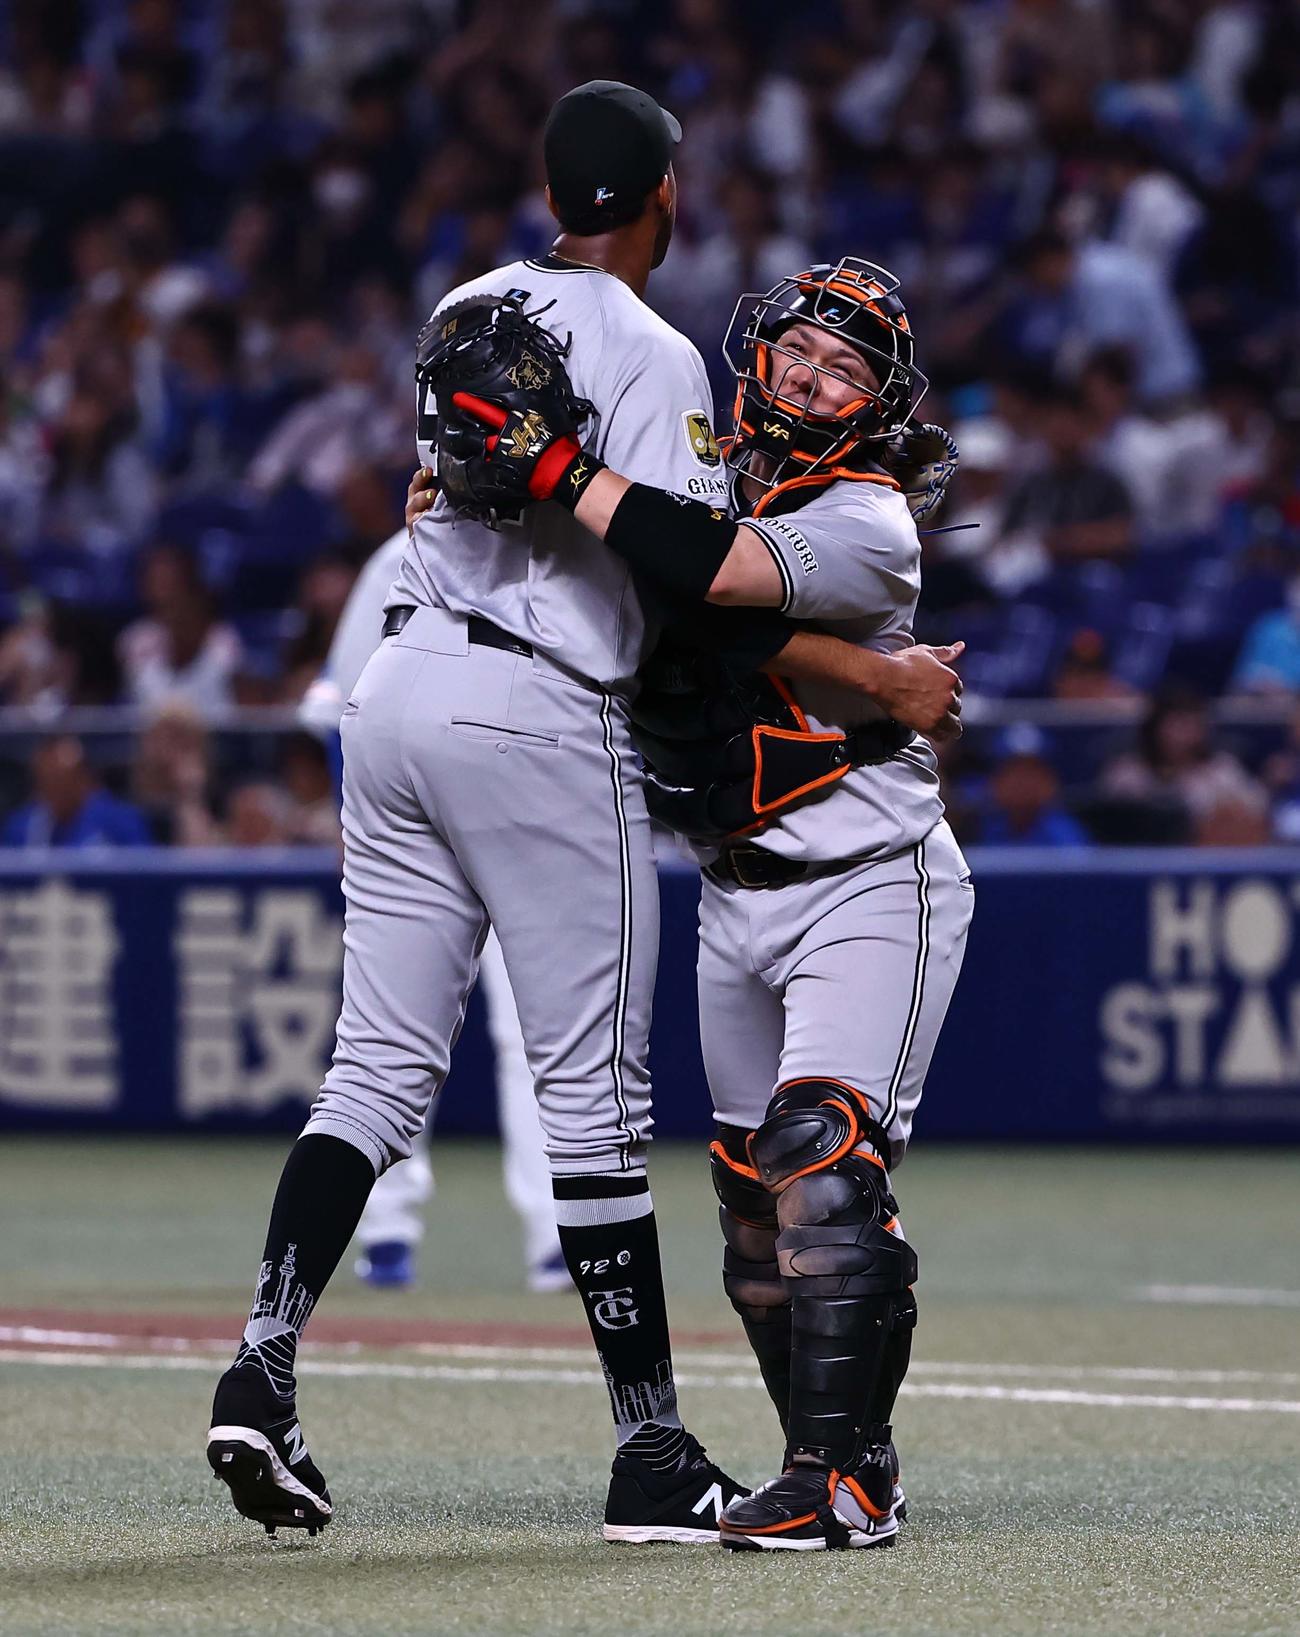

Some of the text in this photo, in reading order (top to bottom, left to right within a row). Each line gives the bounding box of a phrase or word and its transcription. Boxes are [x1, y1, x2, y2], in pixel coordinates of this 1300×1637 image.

[687, 477, 729, 496] GIAN
[1150, 879, 1300, 979] HO
[1101, 984, 1300, 1090] STA
[579, 1259, 610, 1276] 92
